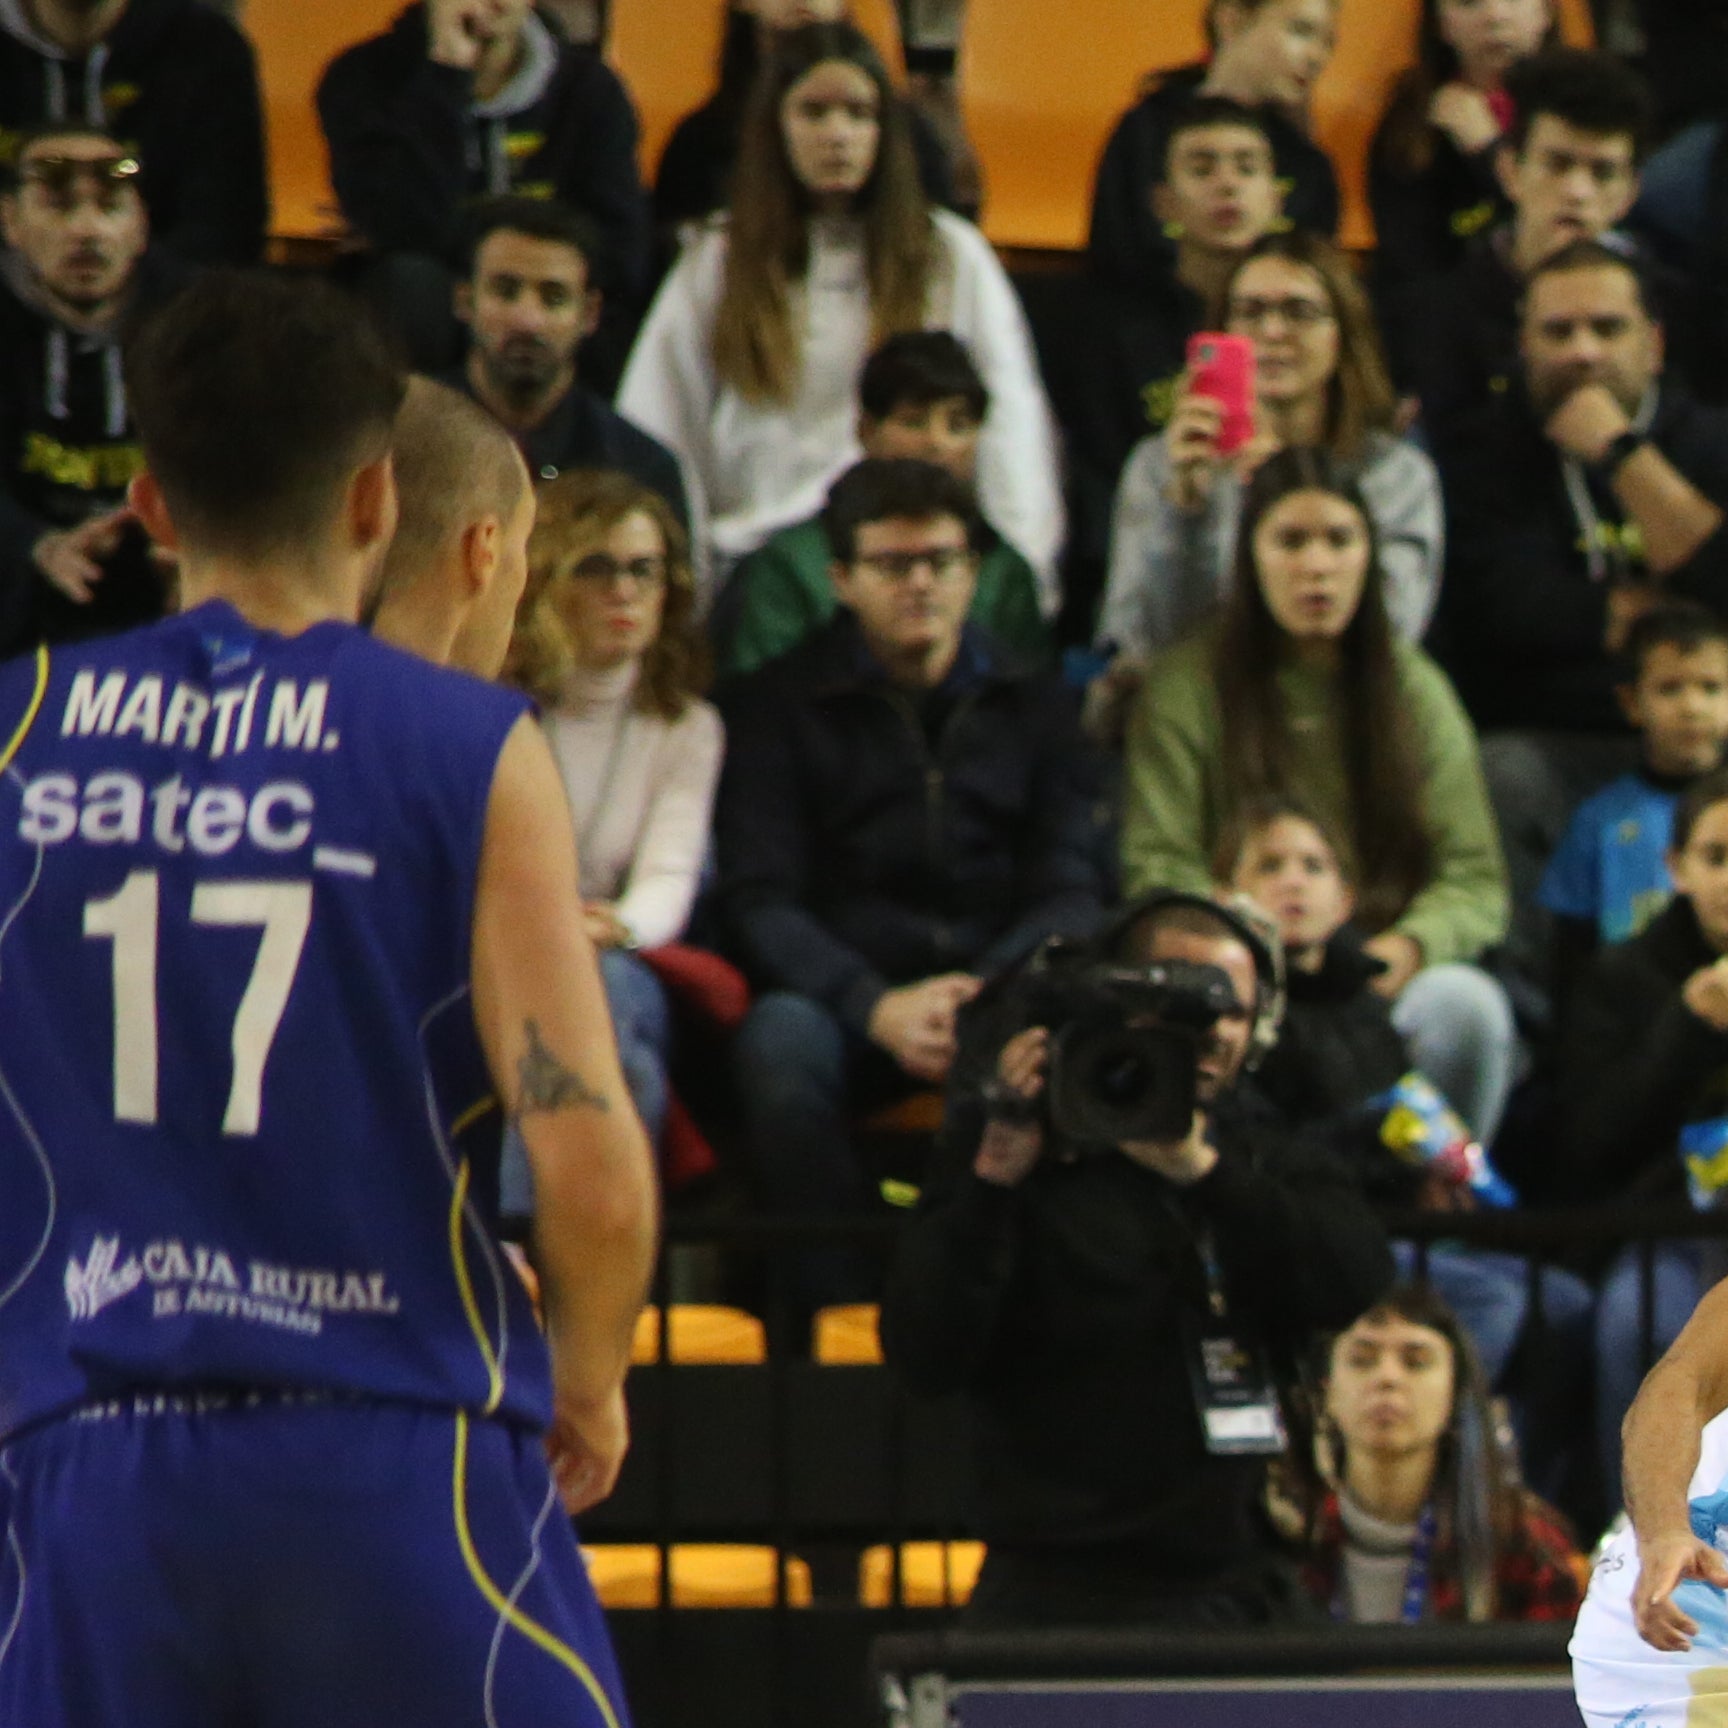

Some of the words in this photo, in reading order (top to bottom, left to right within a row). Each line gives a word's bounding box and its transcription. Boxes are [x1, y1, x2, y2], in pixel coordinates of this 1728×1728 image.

[61, 669, 265, 759] MARTÍ
[266, 680, 340, 751] M.
[82, 868, 314, 1137] 17
[142, 1238, 240, 1292] CAJA
[249, 1258, 399, 1314] RURAL
